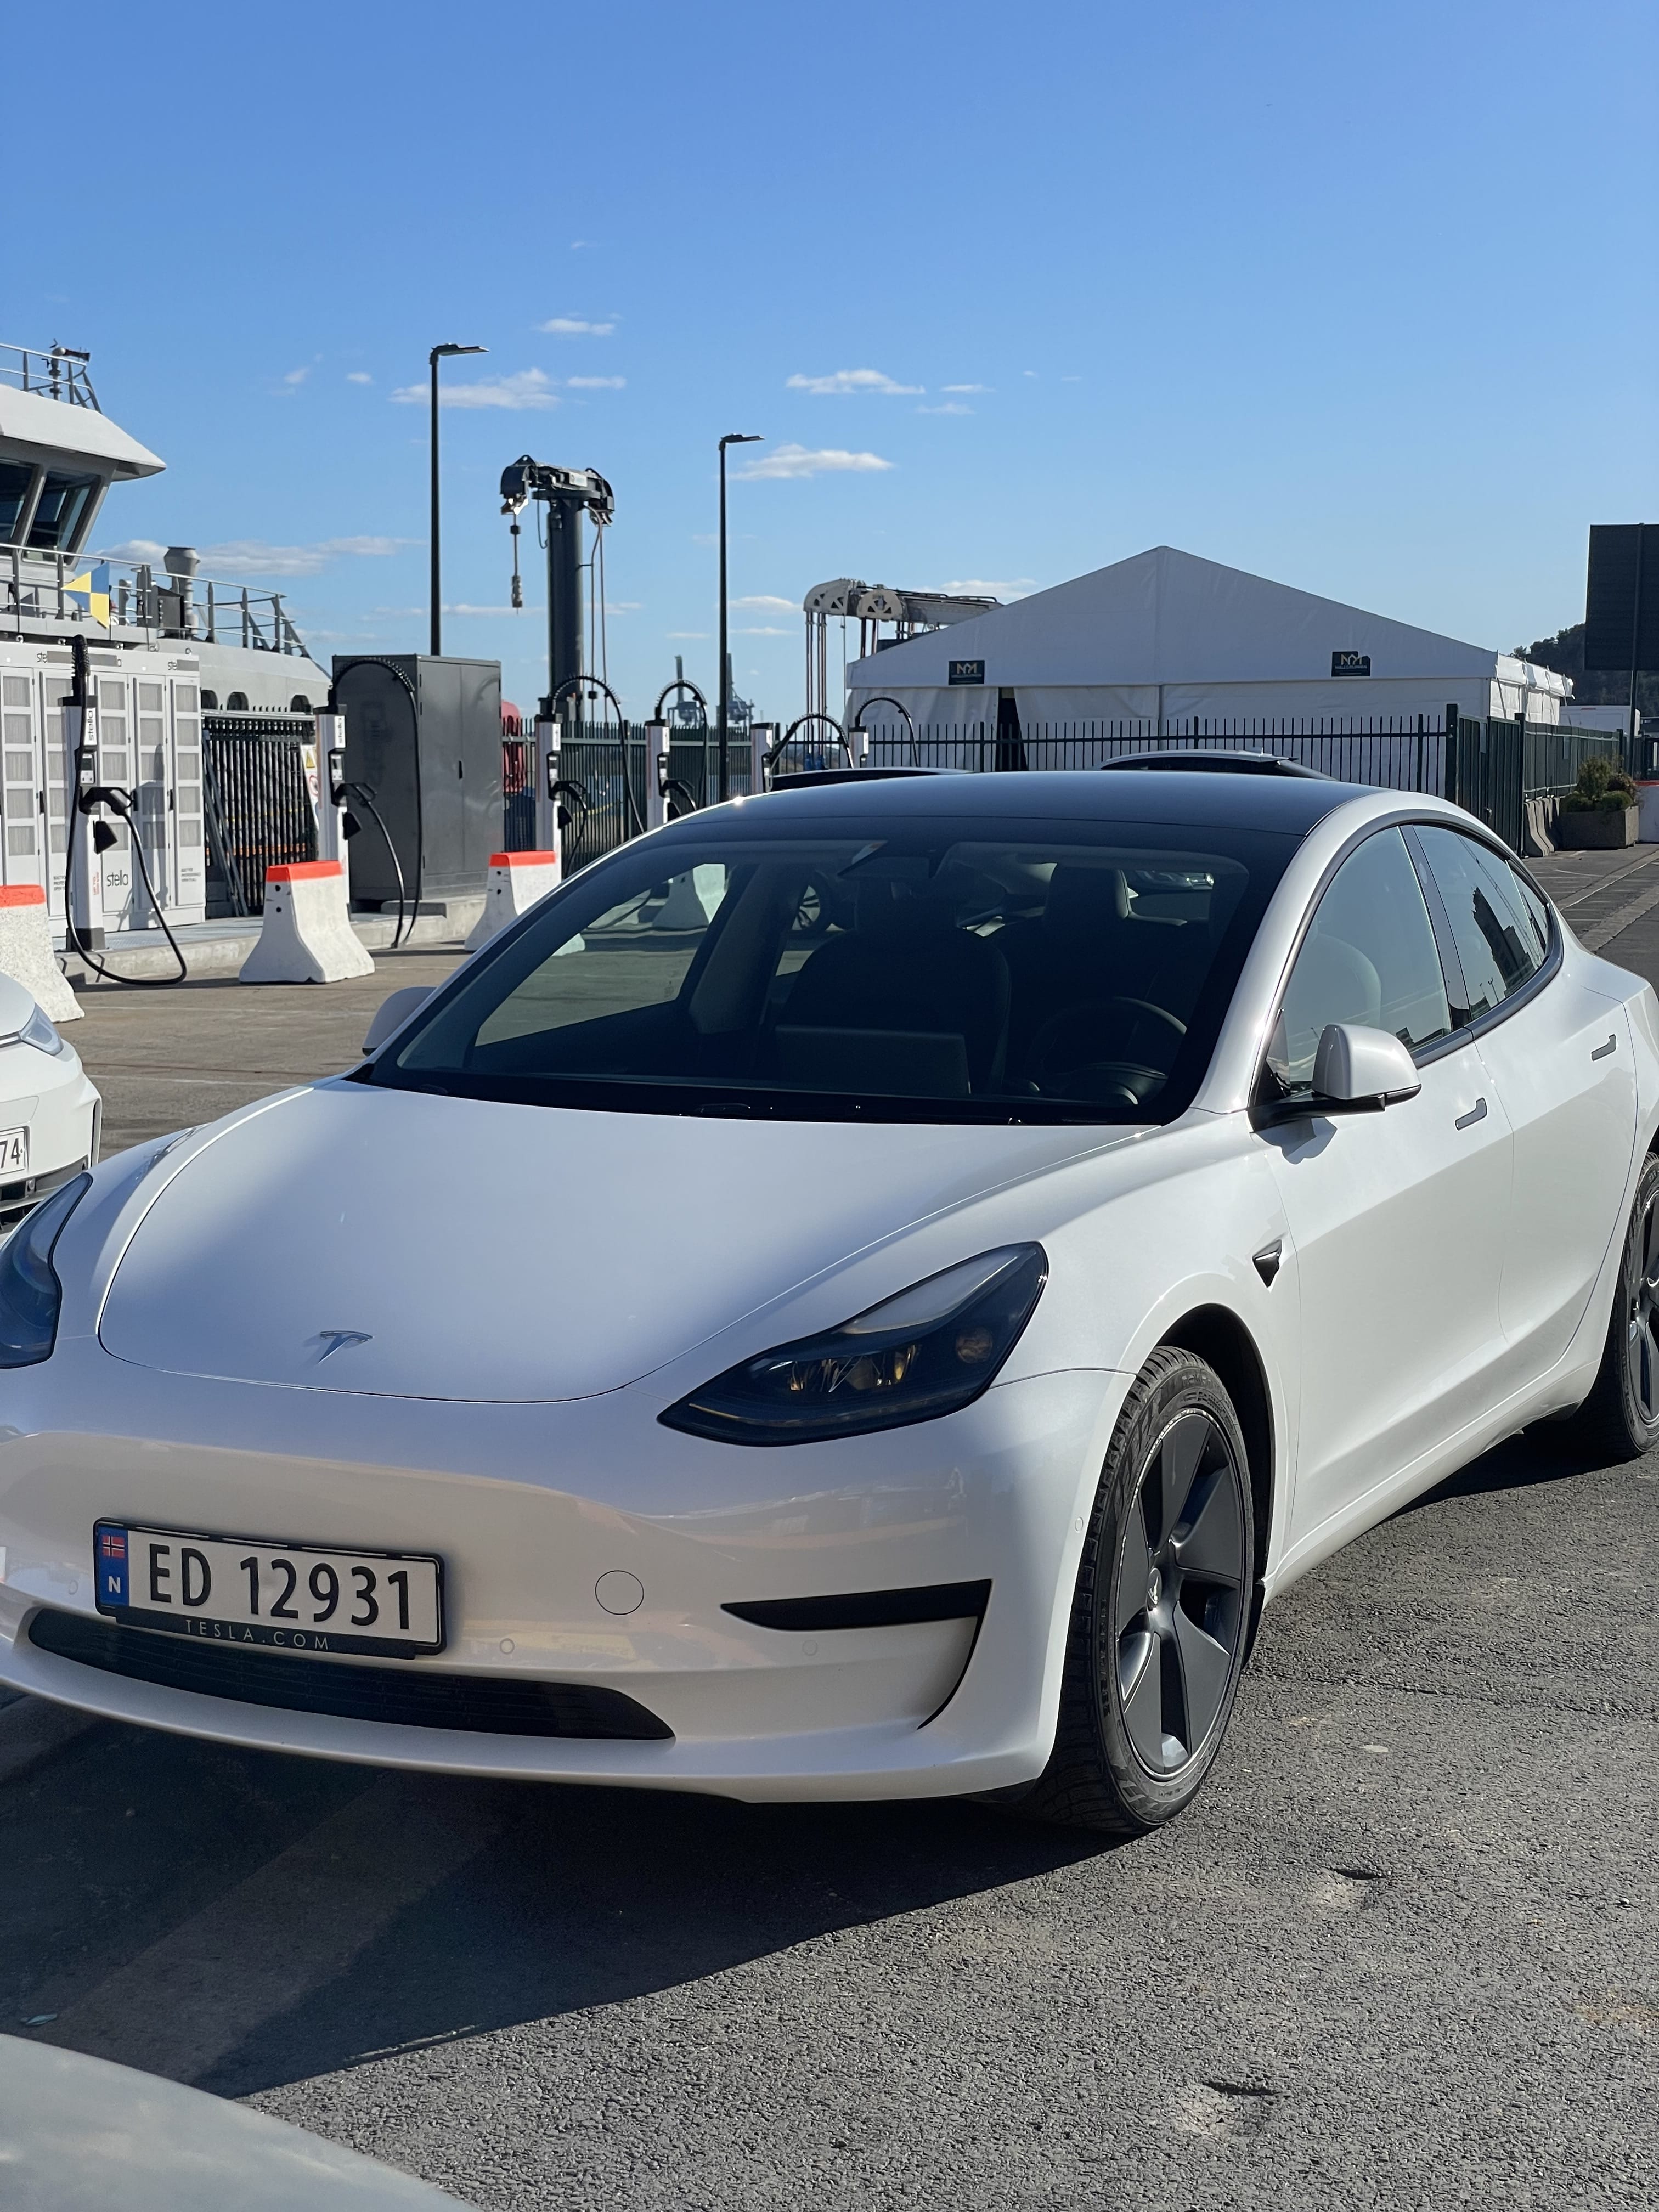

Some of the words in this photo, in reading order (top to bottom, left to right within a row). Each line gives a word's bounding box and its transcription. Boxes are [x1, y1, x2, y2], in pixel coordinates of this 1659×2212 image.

[109, 1575, 121, 1594] N
[149, 1543, 212, 1607] ED
[240, 1556, 410, 1630] 12931
[185, 1618, 329, 1650] TESLA.COM
